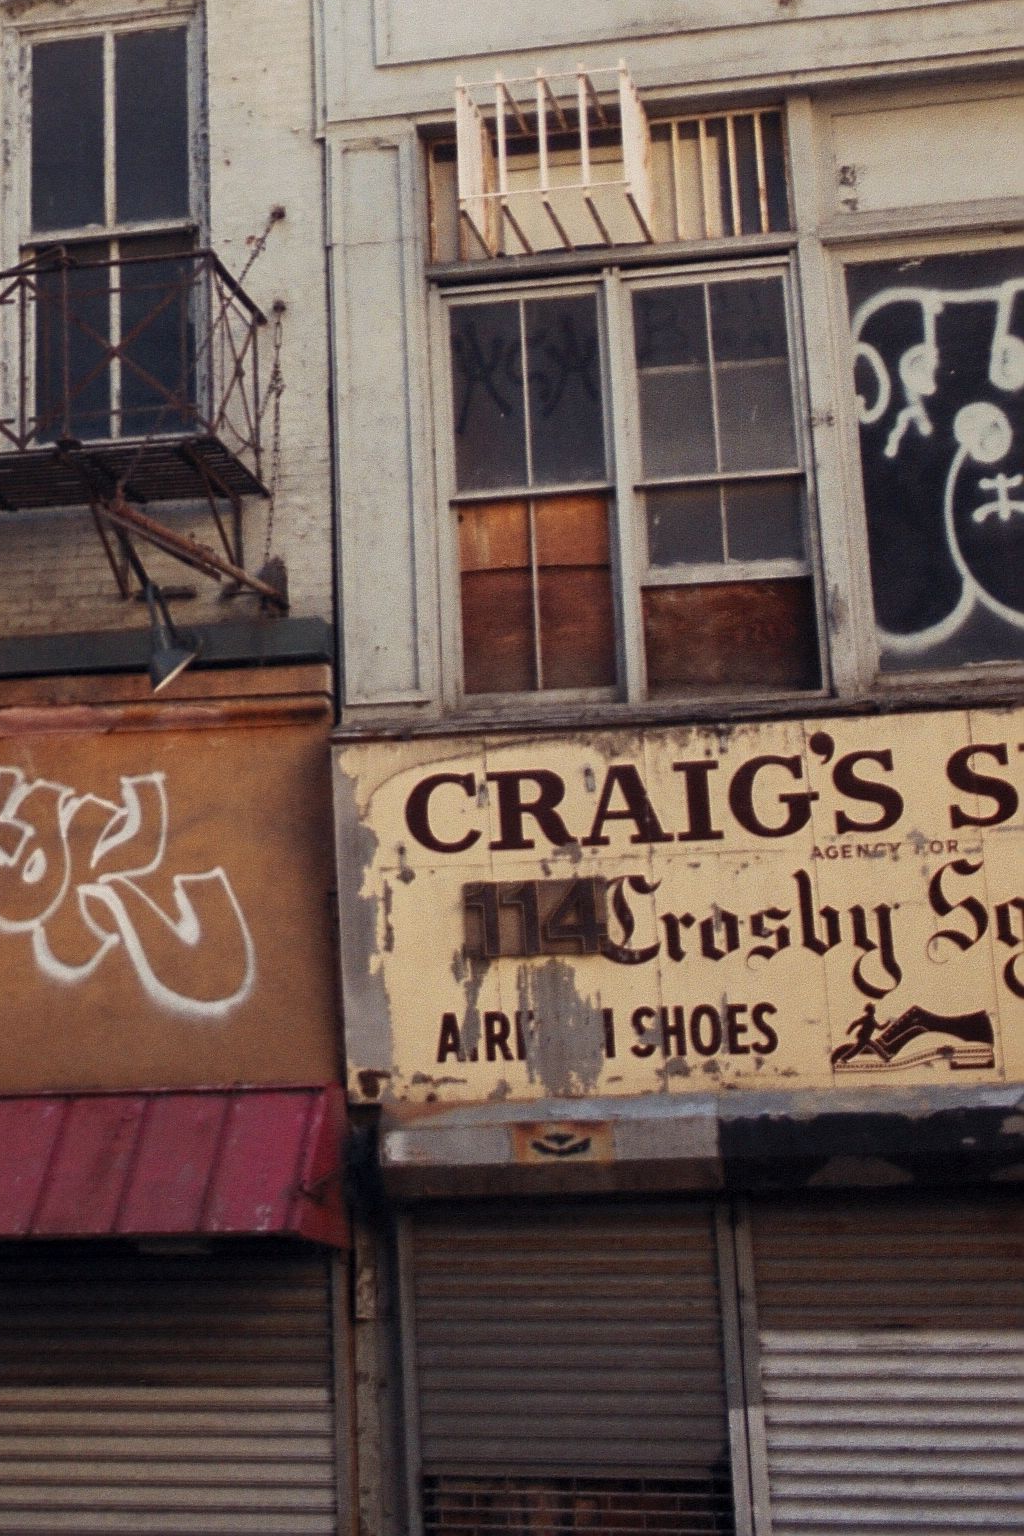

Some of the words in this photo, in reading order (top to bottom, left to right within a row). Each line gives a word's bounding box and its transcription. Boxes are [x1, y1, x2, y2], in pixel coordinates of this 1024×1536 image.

[406, 731, 904, 854] CRAIG'S
[945, 742, 1024, 829] S
[810, 840, 902, 861] AGENCY
[464, 876, 608, 957] 114
[601, 867, 902, 1000] Crosby
[630, 1001, 779, 1058] SHOES
